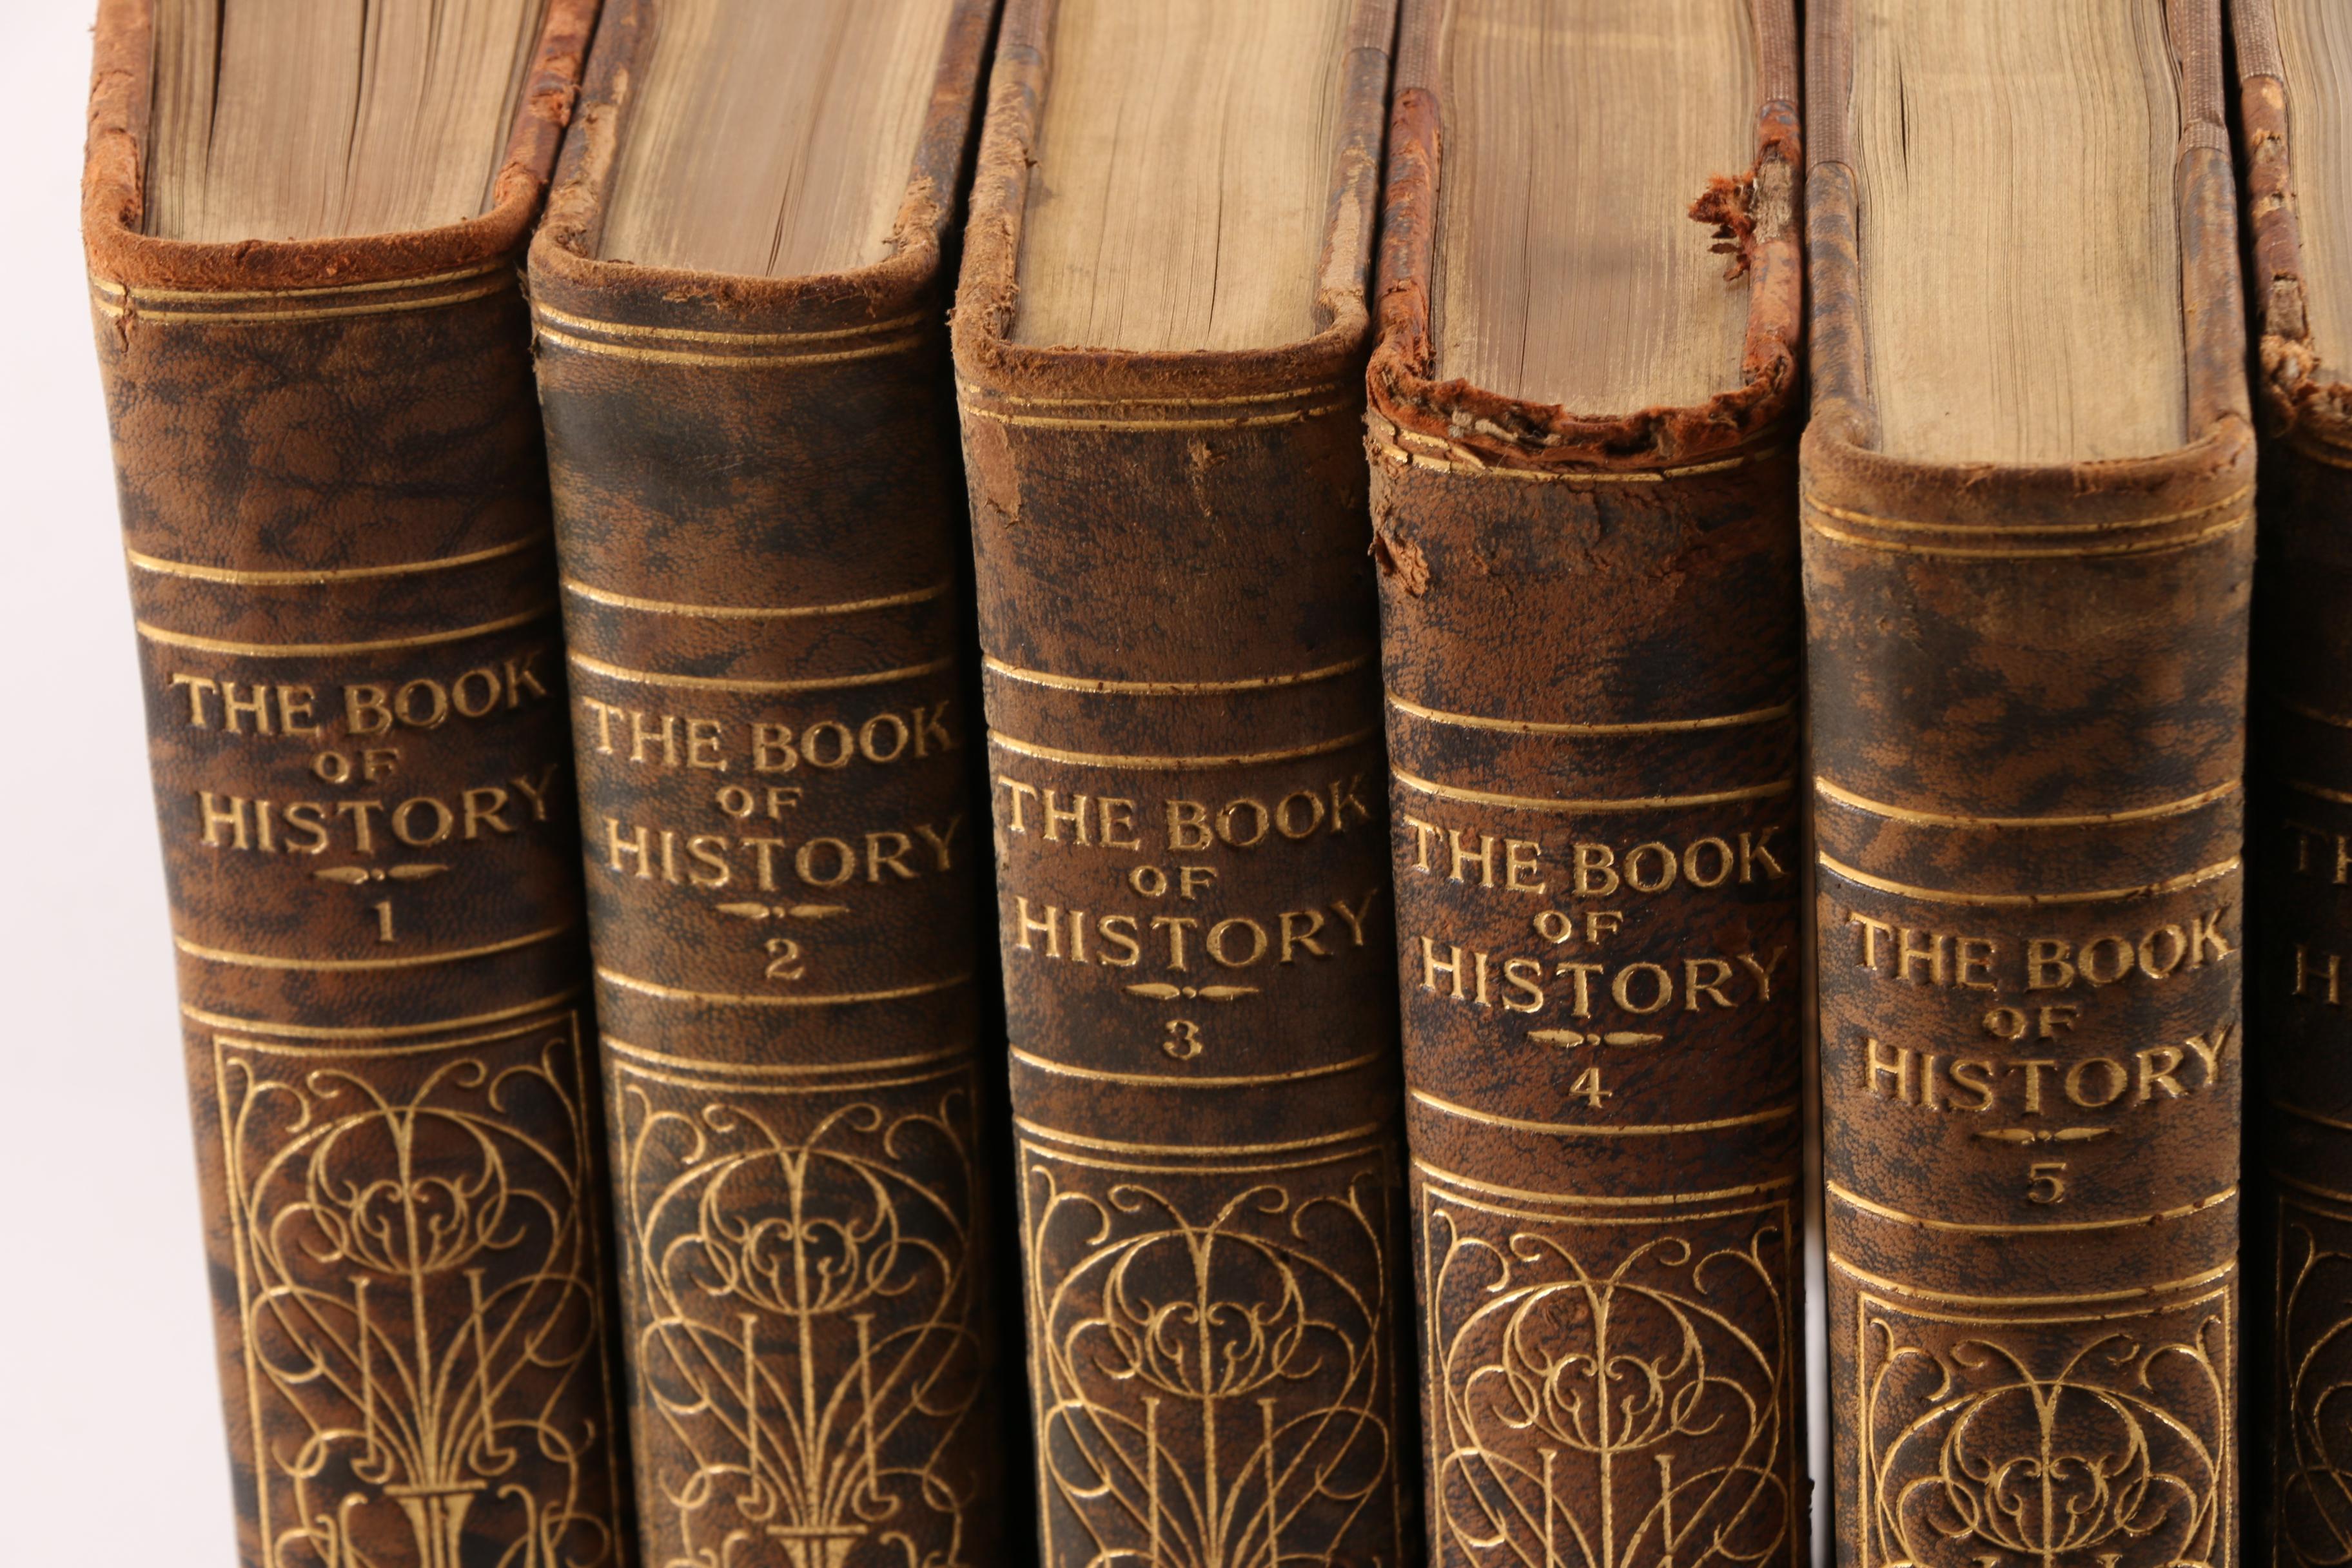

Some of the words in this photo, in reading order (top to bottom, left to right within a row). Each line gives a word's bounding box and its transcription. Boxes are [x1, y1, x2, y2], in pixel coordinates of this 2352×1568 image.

[168, 672, 319, 738] THE
[344, 651, 548, 734] BOOK
[583, 695, 727, 772] THE
[750, 700, 957, 772] BOOK
[311, 747, 400, 784] OF
[197, 765, 558, 854] HISTORY
[715, 784, 803, 820] OF
[997, 775, 1140, 850] THE
[1166, 776, 1371, 851] BOOK
[602, 815, 962, 892] HISTORY
[1129, 865, 1218, 899] OF
[1403, 814, 1546, 894] THE
[1573, 826, 1788, 897] BOOK
[373, 901, 395, 942] 1
[1014, 889, 1378, 971] HISTORY
[1533, 910, 1623, 945] OF
[1848, 911, 1998, 992] THE
[2024, 905, 2239, 993] BOOK
[764, 938, 805, 981] 2
[1419, 937, 1787, 1019] HISTORY
[1162, 1019, 1202, 1061] 3
[1983, 1004, 2080, 1040] OF
[1569, 1067, 1612, 1109] 4
[1863, 1021, 2236, 1115] HISTORY
[2028, 1162, 2067, 1204] 5
